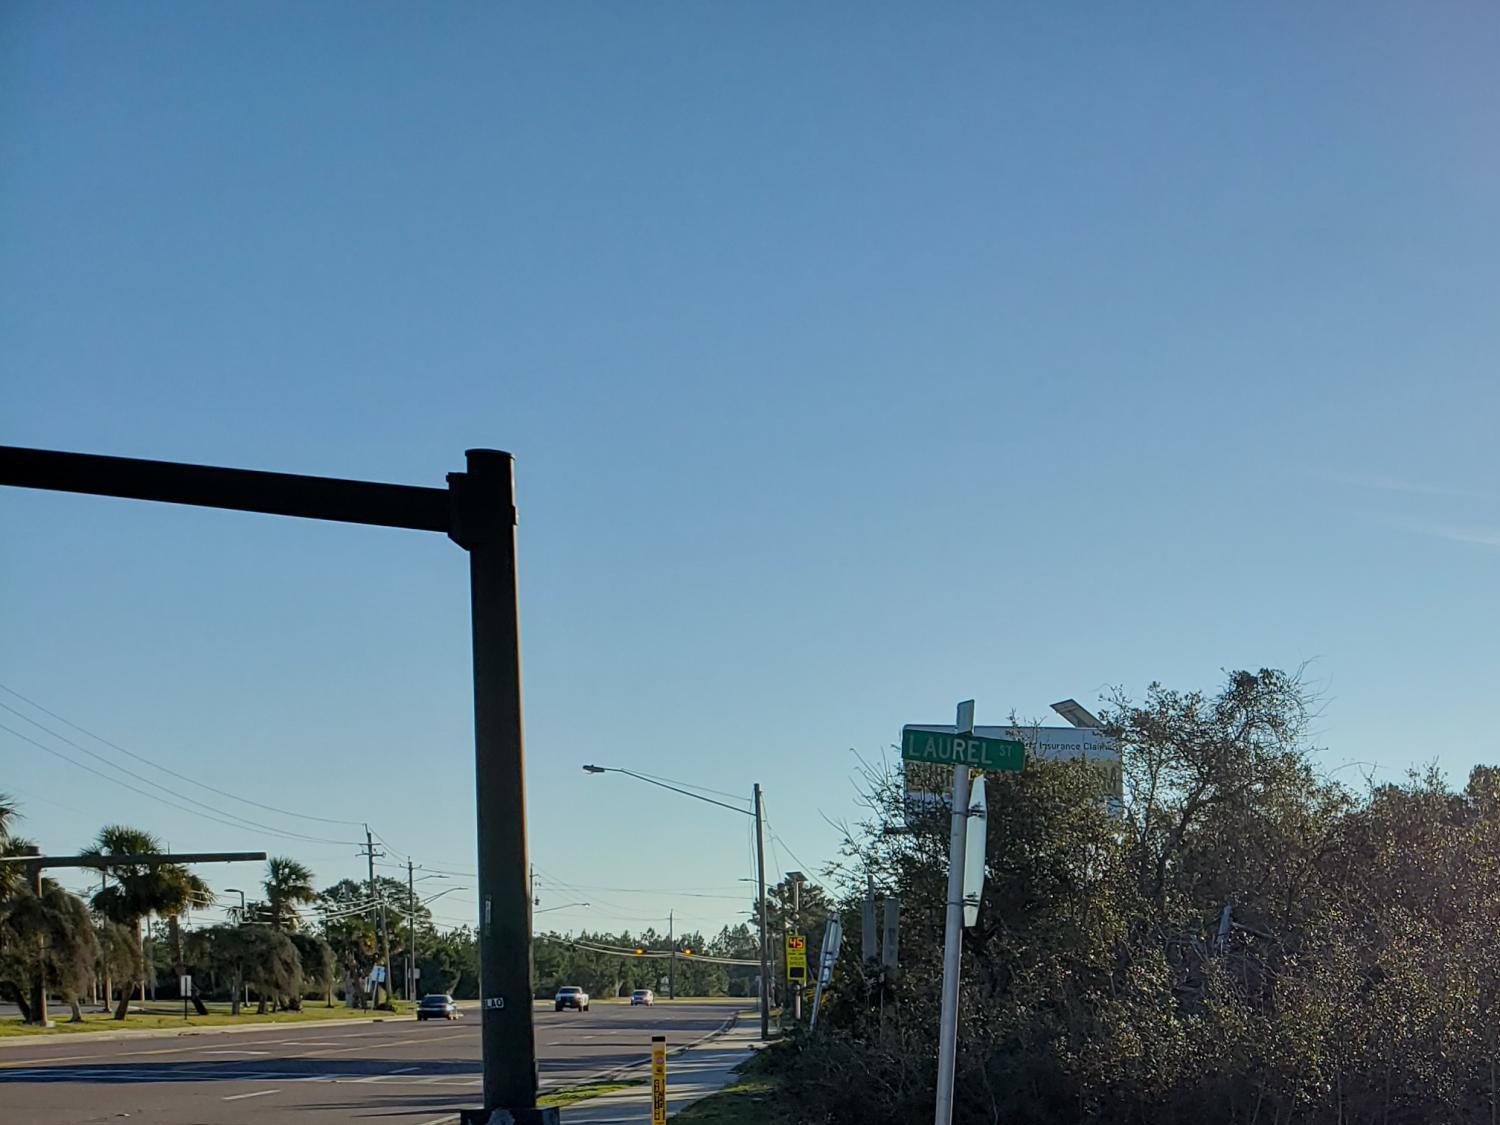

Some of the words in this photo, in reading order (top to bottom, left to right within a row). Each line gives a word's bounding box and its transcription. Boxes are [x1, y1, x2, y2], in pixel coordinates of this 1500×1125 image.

[908, 734, 993, 765] LAUREL
[999, 744, 1013, 758] ST
[1039, 741, 1081, 751] Insurance
[789, 937, 804, 949] 45
